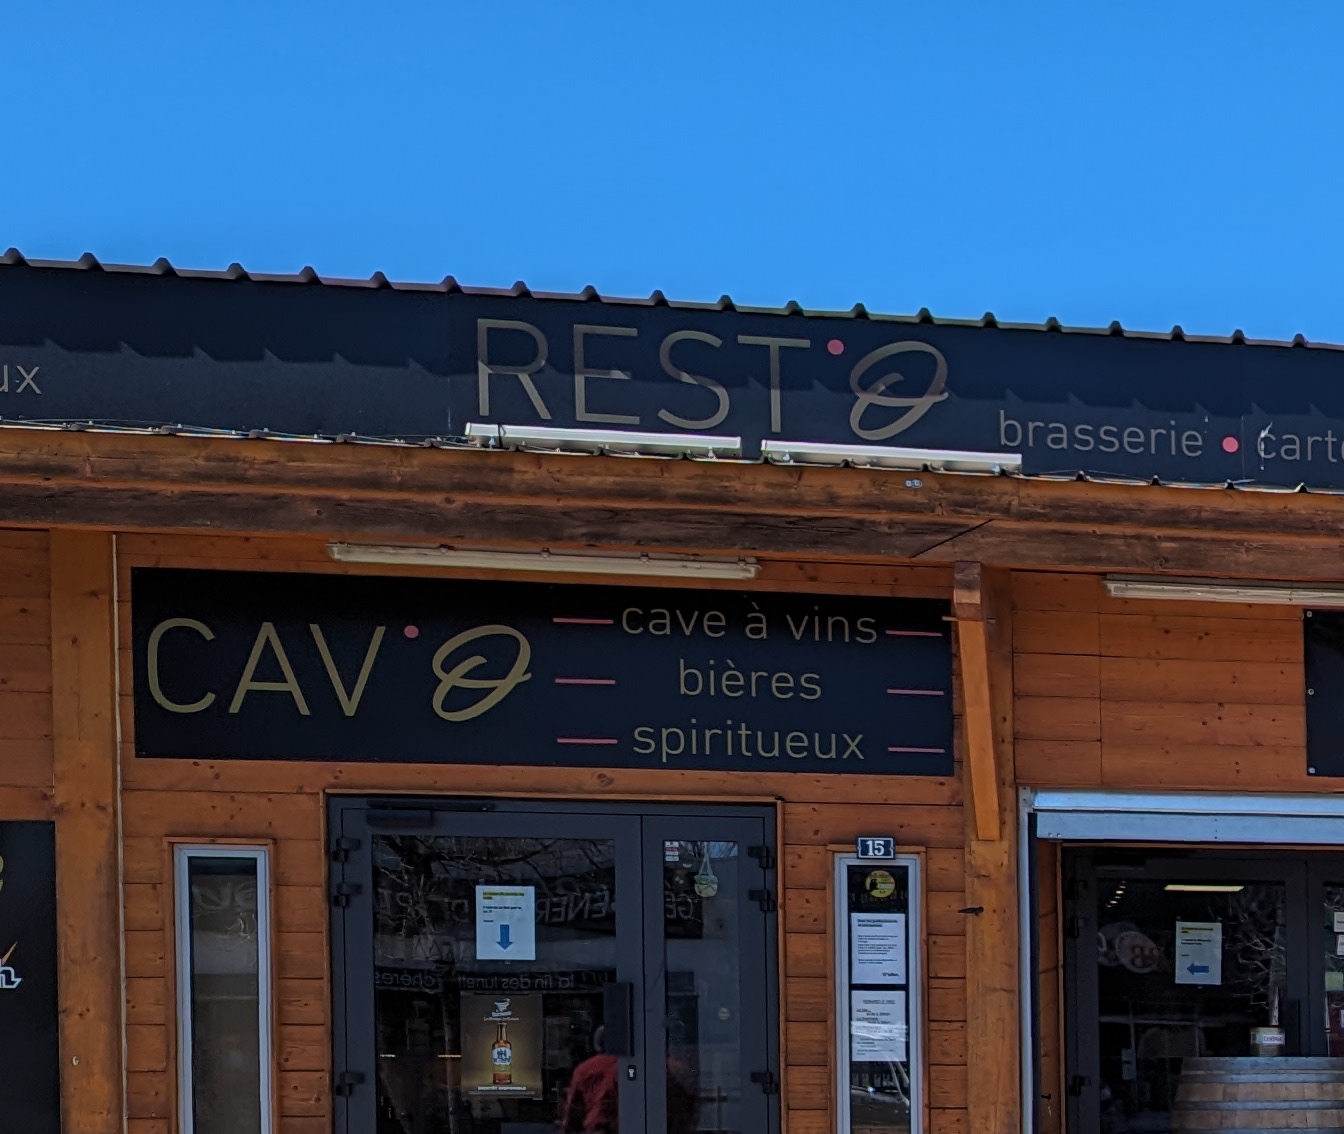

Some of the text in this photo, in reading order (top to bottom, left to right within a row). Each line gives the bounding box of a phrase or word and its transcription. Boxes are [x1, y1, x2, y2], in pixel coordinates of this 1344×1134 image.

[1000, 410, 1203, 457] brasserie
[620, 601, 879, 645] cave à vins
[678, 659, 823, 702] bières
[631, 718, 865, 763] spiritueux
[866, 840, 885, 856] 15
